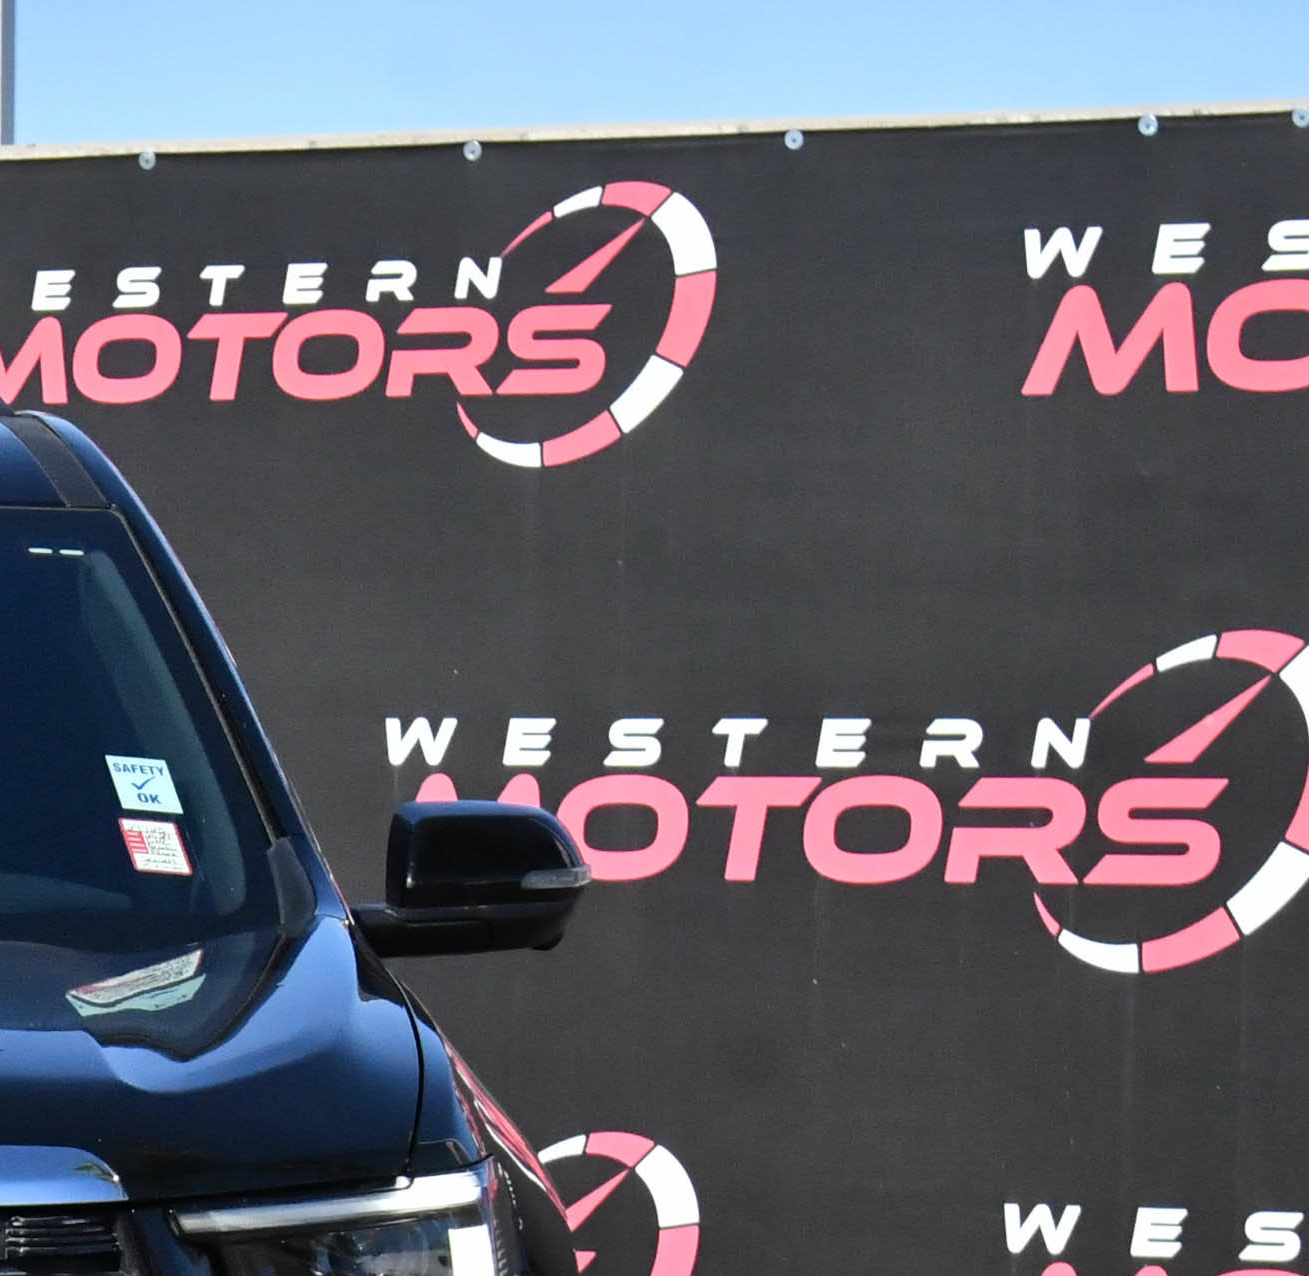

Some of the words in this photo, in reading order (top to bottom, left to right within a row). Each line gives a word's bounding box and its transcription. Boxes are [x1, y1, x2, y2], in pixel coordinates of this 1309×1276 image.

[384, 715, 1092, 769] WESTERN
[112, 762, 165, 777] SAFETY
[136, 793, 162, 806] OK
[414, 772, 1230, 886] OTORS
[1003, 1202, 1304, 1263] WES
